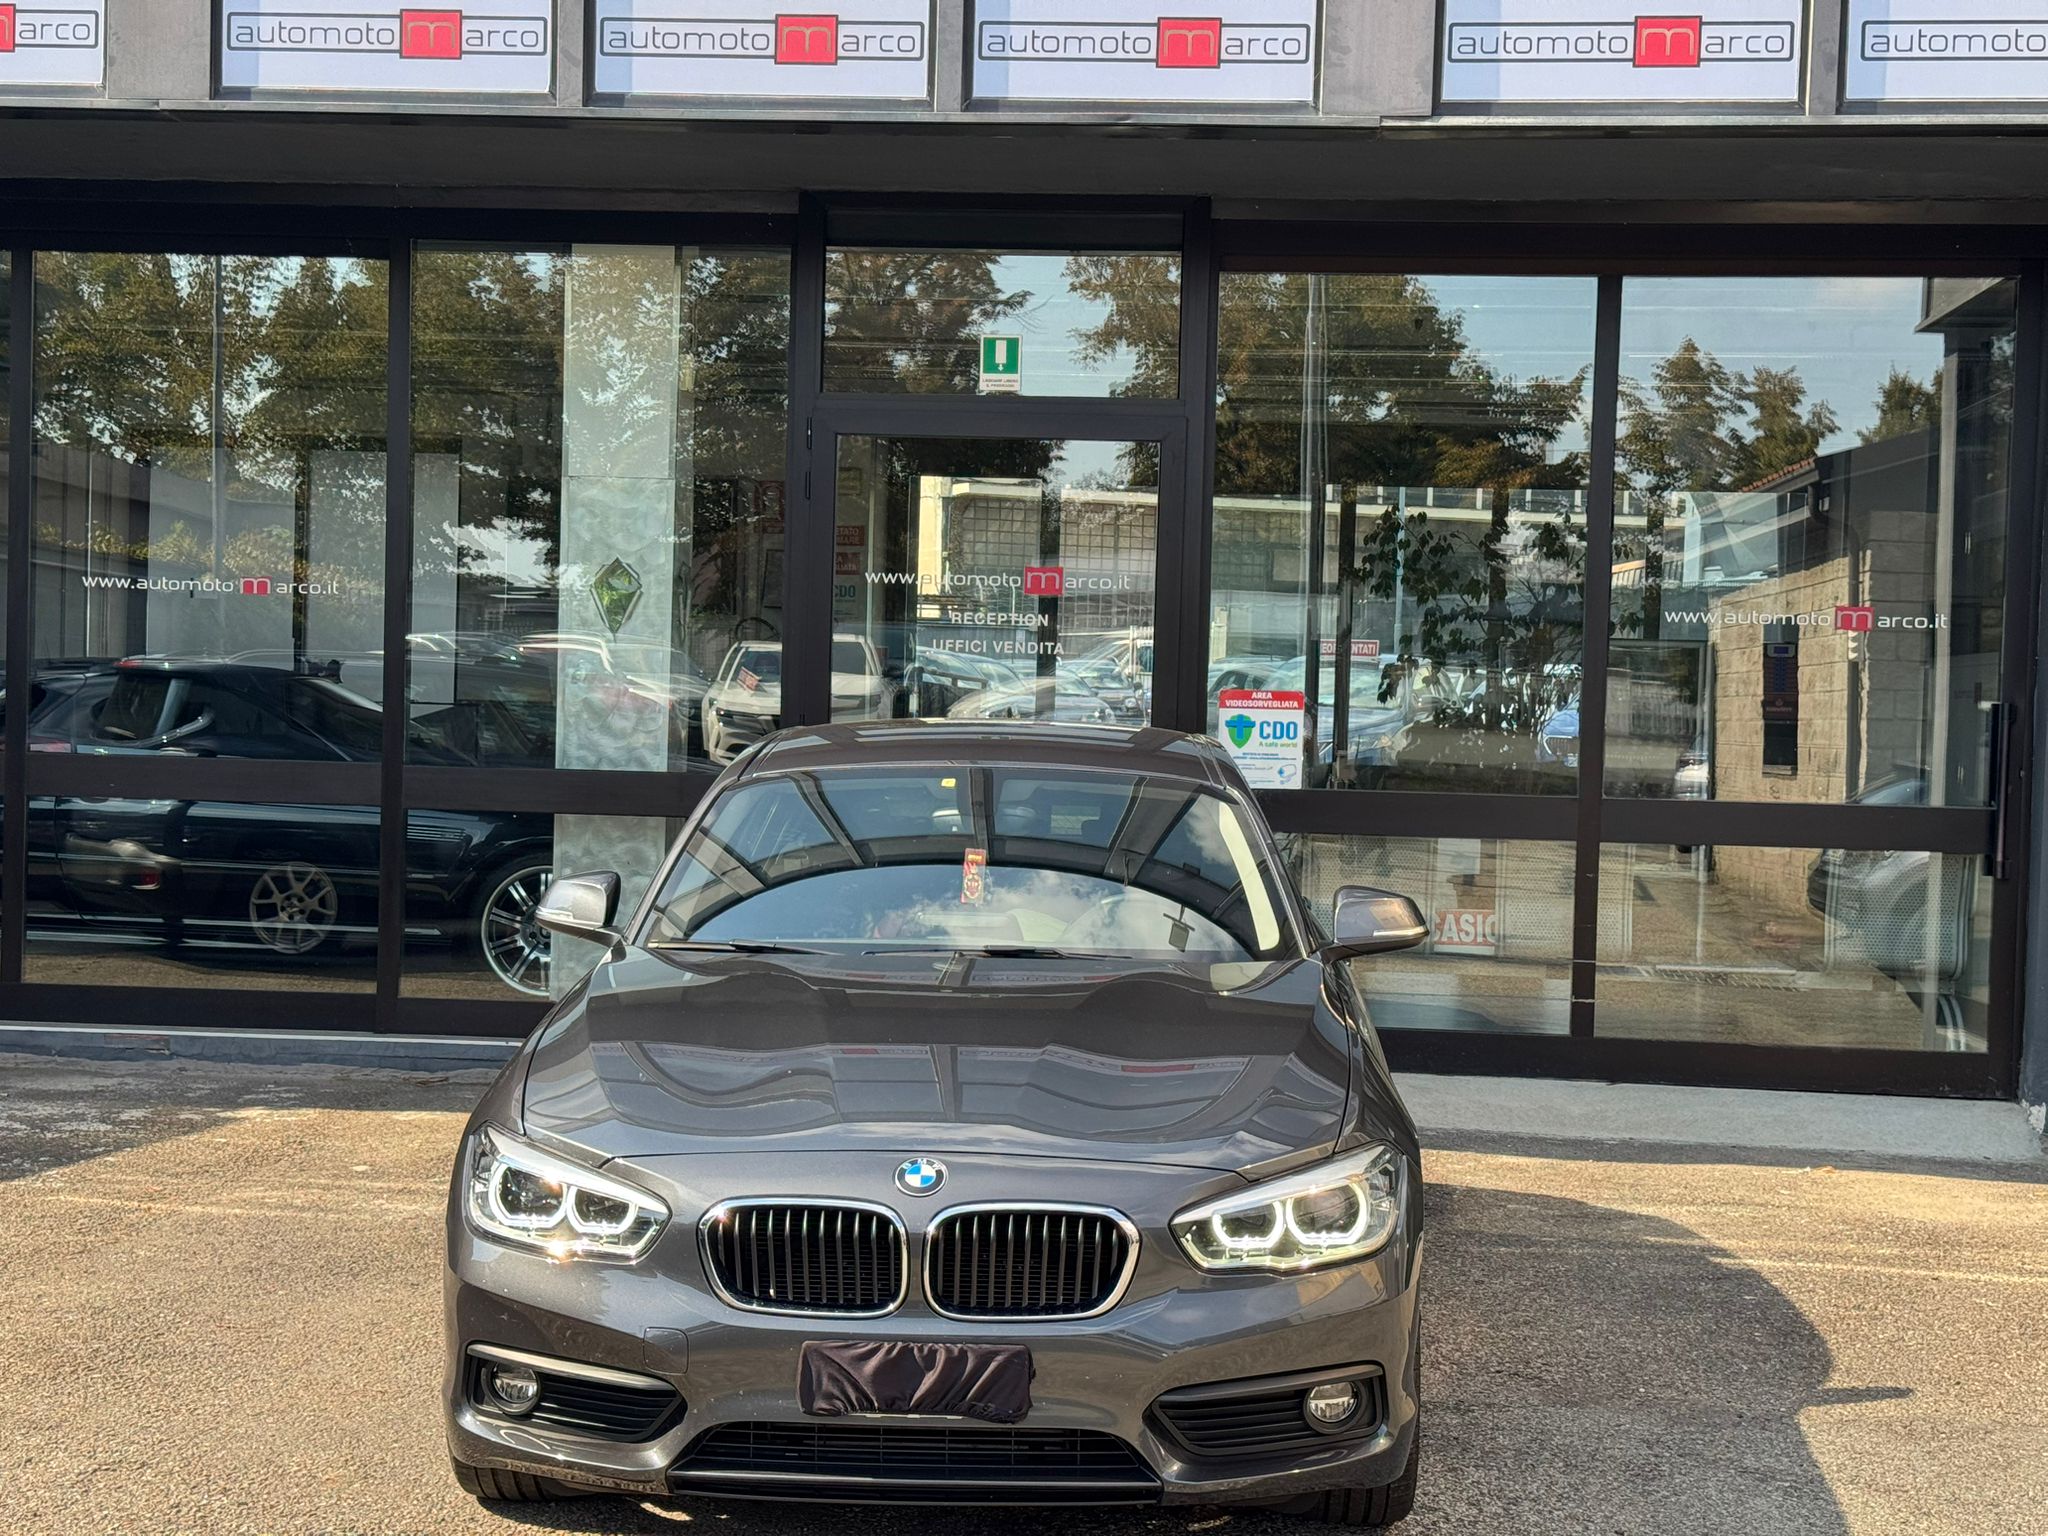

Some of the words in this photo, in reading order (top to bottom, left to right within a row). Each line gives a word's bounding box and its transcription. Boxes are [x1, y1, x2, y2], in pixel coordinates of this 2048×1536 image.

[1871, 29, 2046, 53] automoto
[952, 612, 1049, 627] RECEPTION
[933, 639, 987, 653] UFFICI
[992, 640, 1065, 655] VENDITA
[1251, 691, 1273, 699] AREA
[1225, 699, 1299, 709] VIDEOSORVEGLIATA
[1259, 720, 1298, 740] CDO
